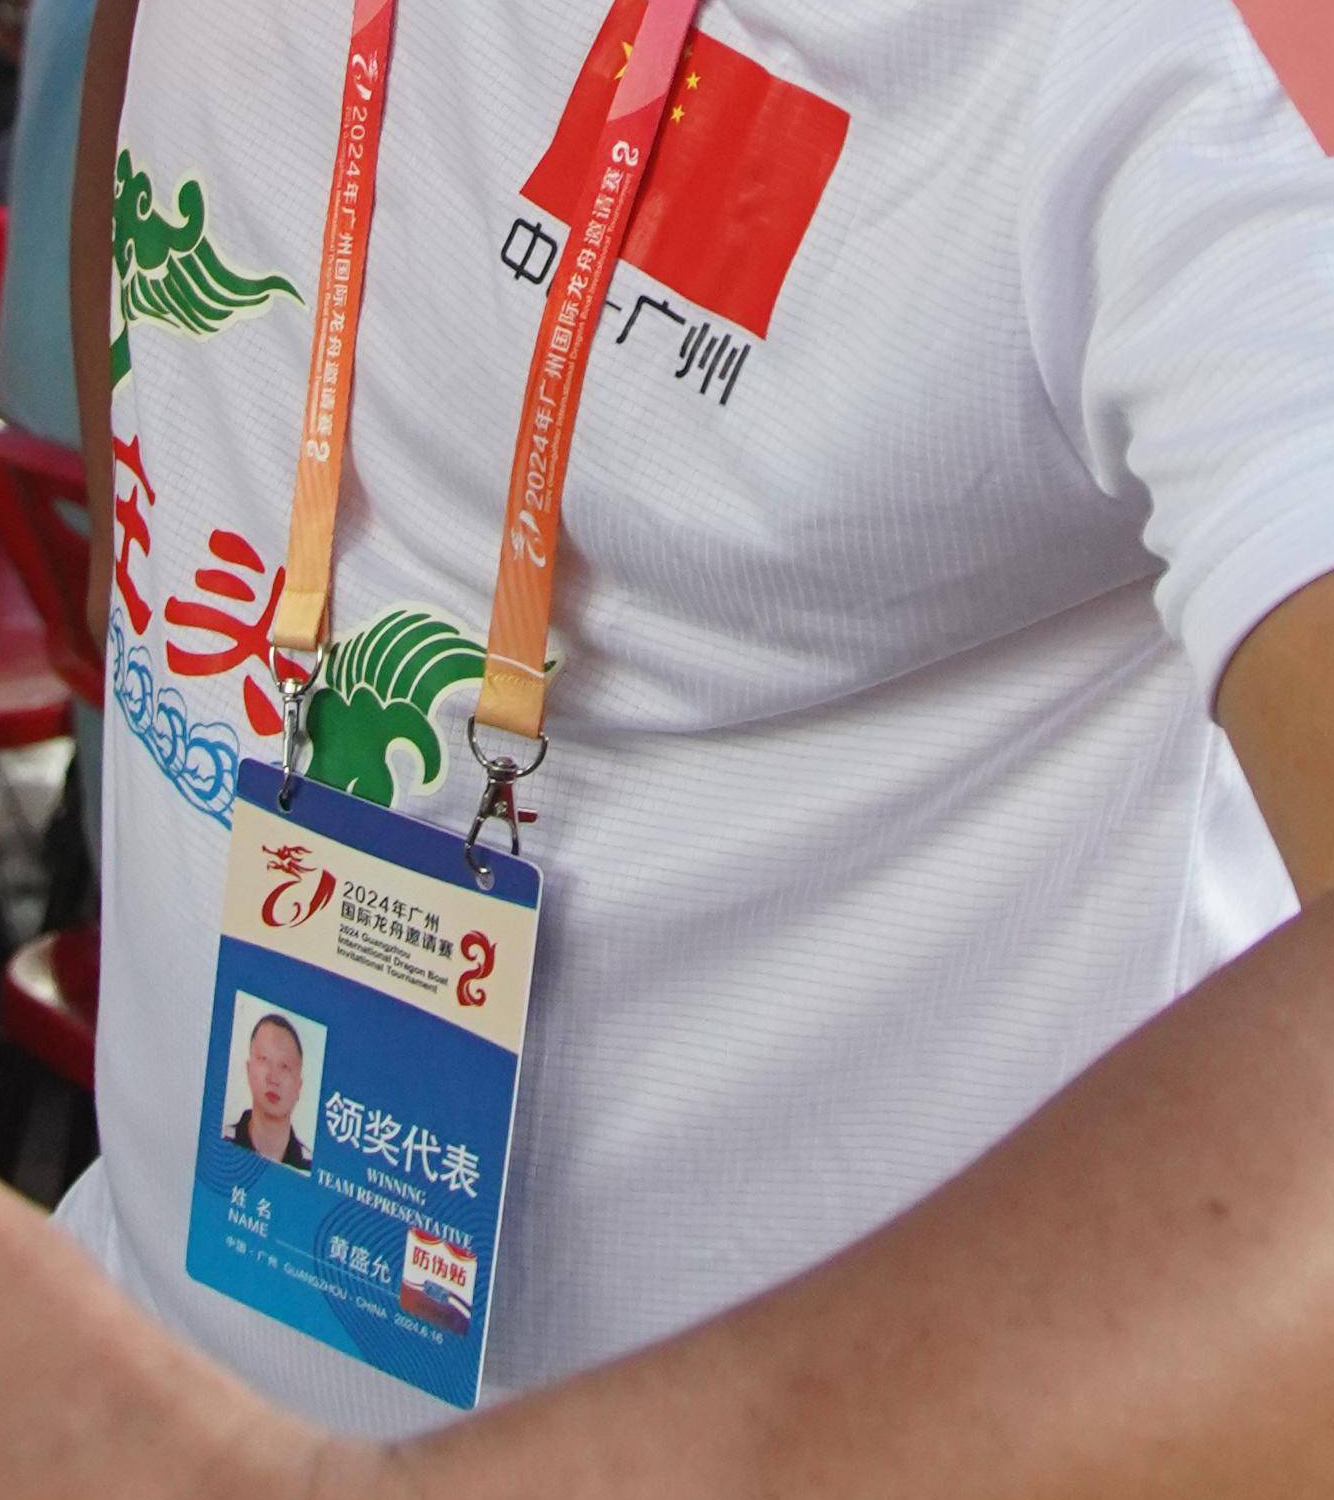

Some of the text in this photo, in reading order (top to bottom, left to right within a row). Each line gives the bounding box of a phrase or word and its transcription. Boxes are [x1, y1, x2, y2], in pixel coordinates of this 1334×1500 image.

[316, 104, 368, 436] 2024年广州国际龙舟邀请赛
[524, 164, 624, 511] 2024年广州国际龙舟邀请赛
[340, 901, 454, 960] 国际龙舟邀请赛
[342, 881, 440, 933] 2024年广州
[324, 1091, 481, 1198] 领奖代表
[317, 1168, 474, 1250] TEAM REPRESENTATIVE
[367, 1167, 427, 1207] WINNING
[227, 1207, 268, 1238] NAME
[412, 1245, 467, 1288] 防伪贴
